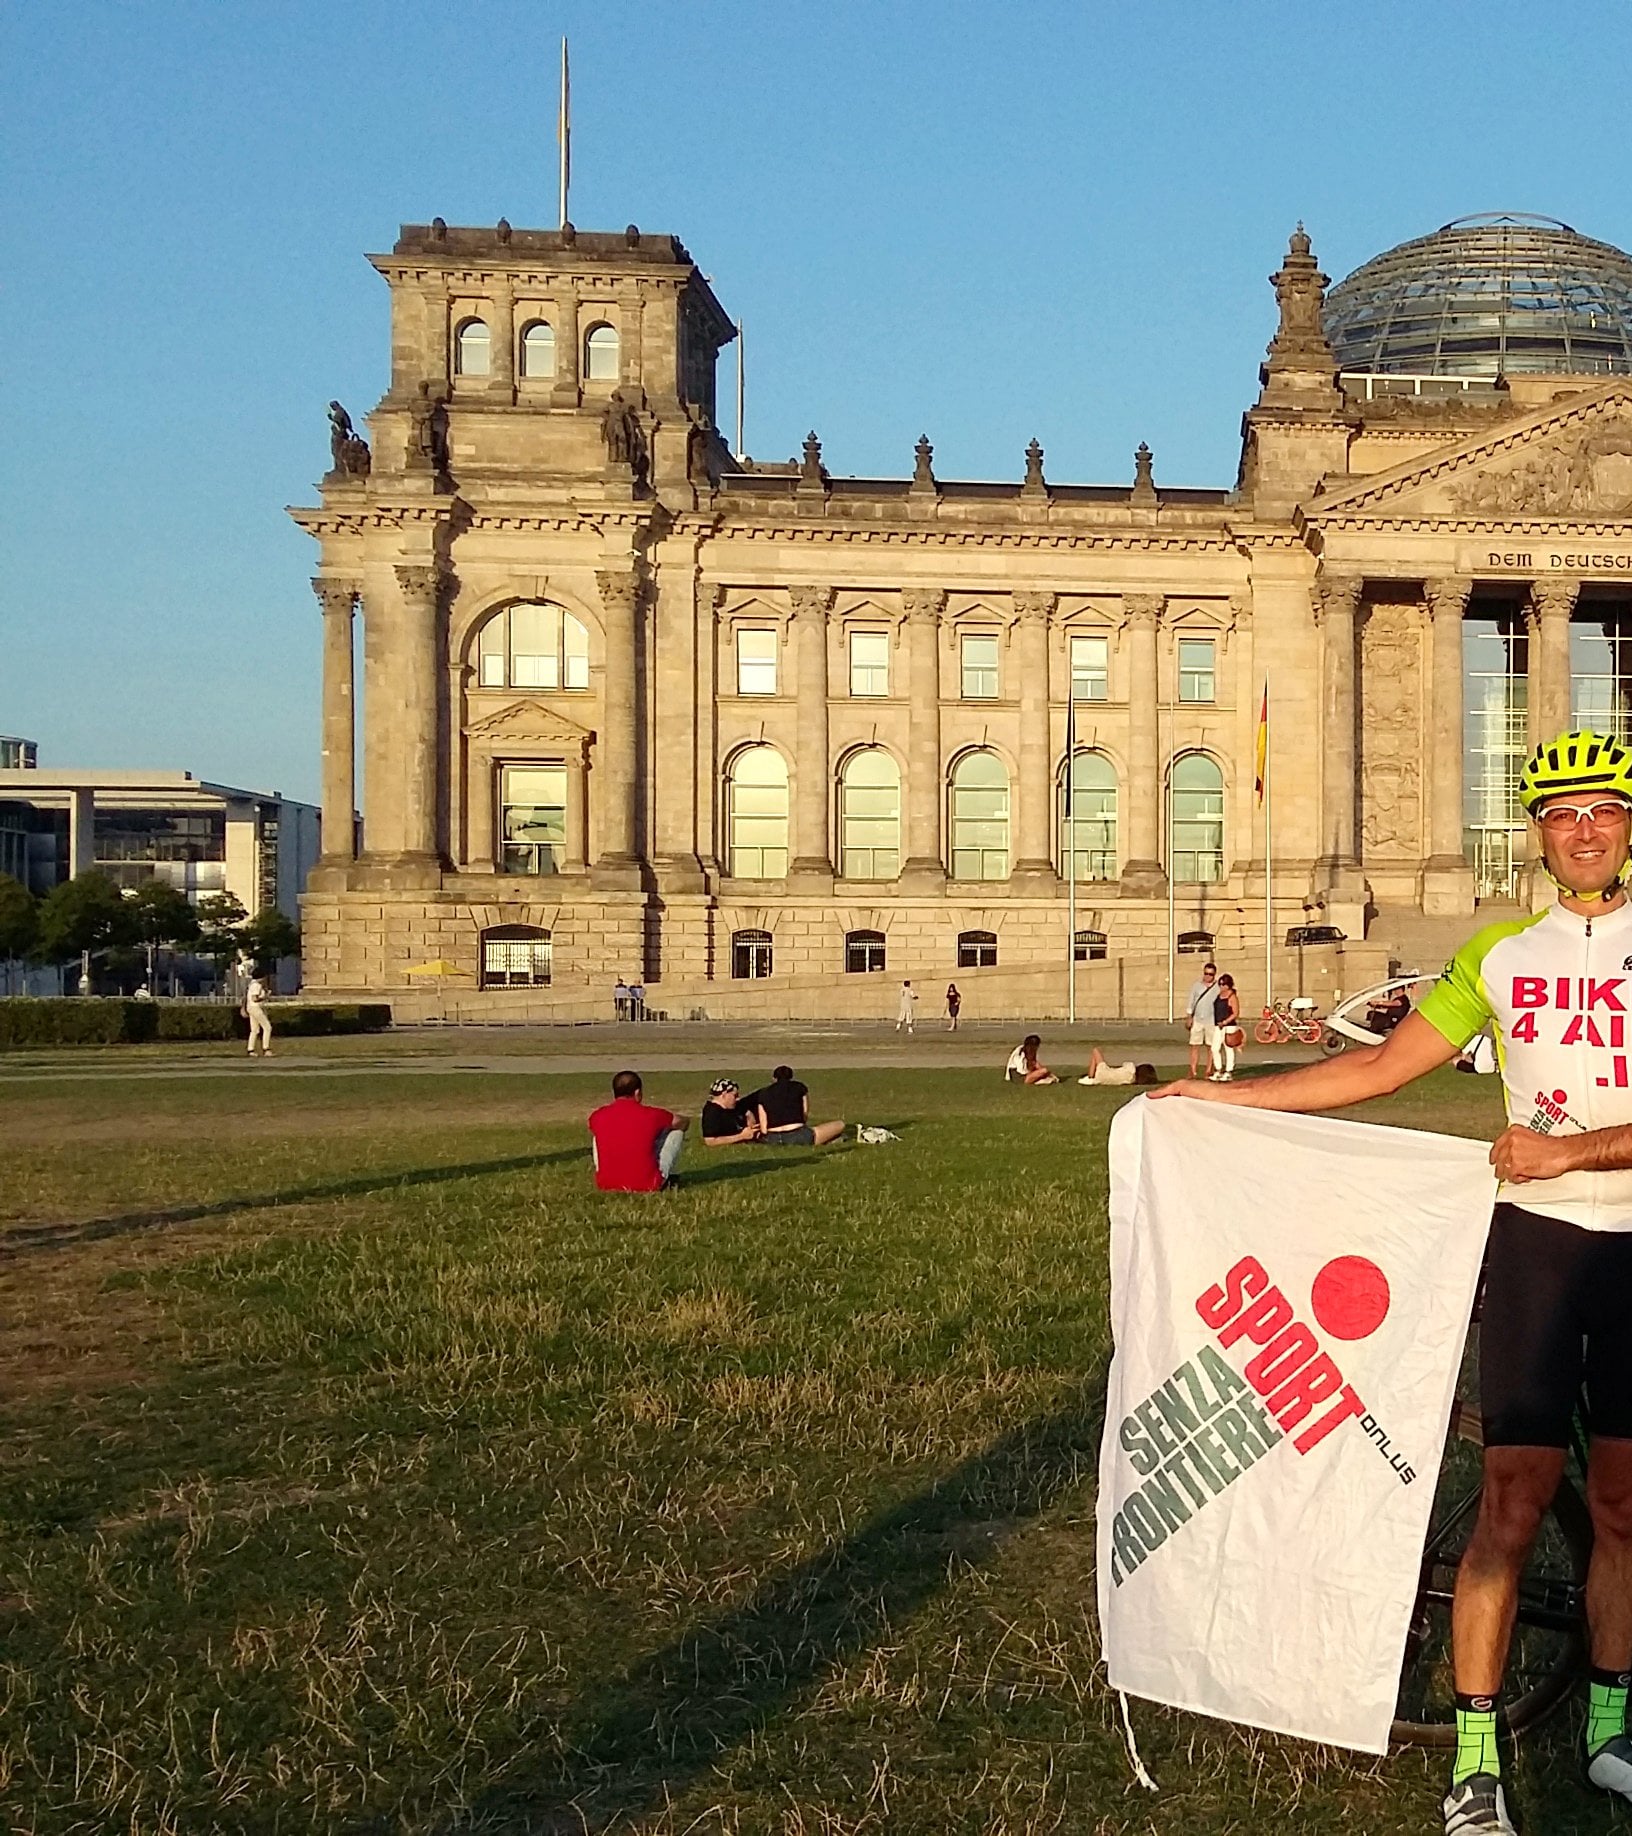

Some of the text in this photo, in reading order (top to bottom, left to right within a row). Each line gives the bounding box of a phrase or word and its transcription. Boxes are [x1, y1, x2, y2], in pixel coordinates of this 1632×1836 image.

[1487, 553, 1532, 567] DEM
[1511, 1011, 1539, 1044] 4
[1534, 1091, 1570, 1125] SPORT
[1195, 1255, 1367, 1456] SPORT
[1119, 1344, 1248, 1476] SENZA
[1360, 1413, 1417, 1486] ONLUS
